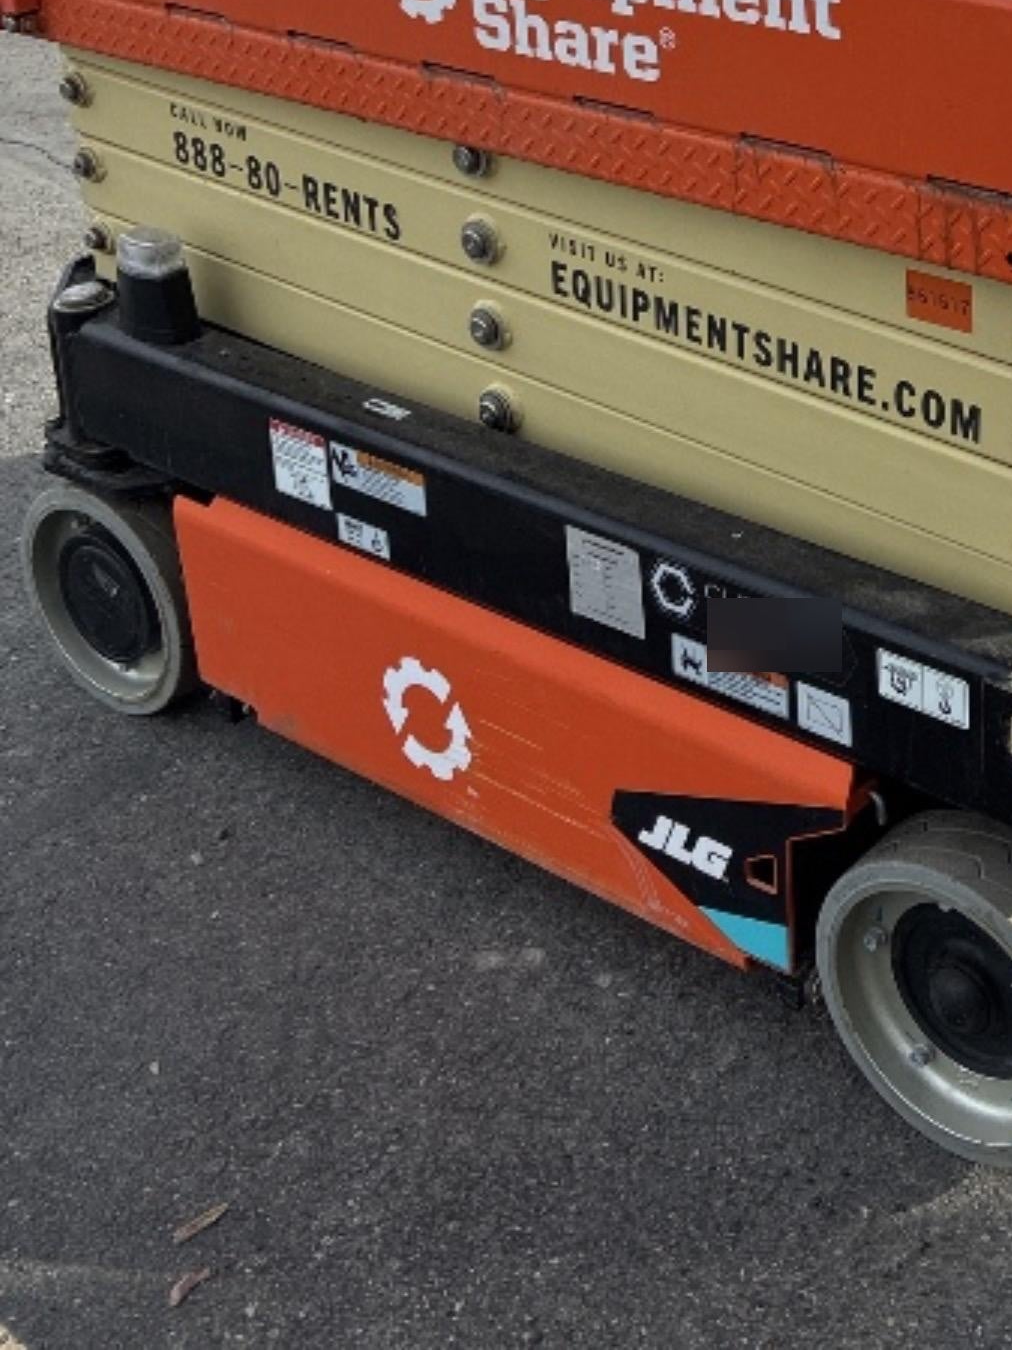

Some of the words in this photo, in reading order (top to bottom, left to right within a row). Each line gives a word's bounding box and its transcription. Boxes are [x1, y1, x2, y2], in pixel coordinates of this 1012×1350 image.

[169, 101, 208, 130] CALL
[213, 116, 248, 142] NOW
[173, 131, 401, 241] 888-80-RENTS
[548, 232, 596, 263] VISIT
[604, 250, 628, 272] US
[635, 259, 665, 284] AT:
[550, 260, 982, 445] EQUIPMENTSHARE.COM
[637, 815, 733, 881] JLG
